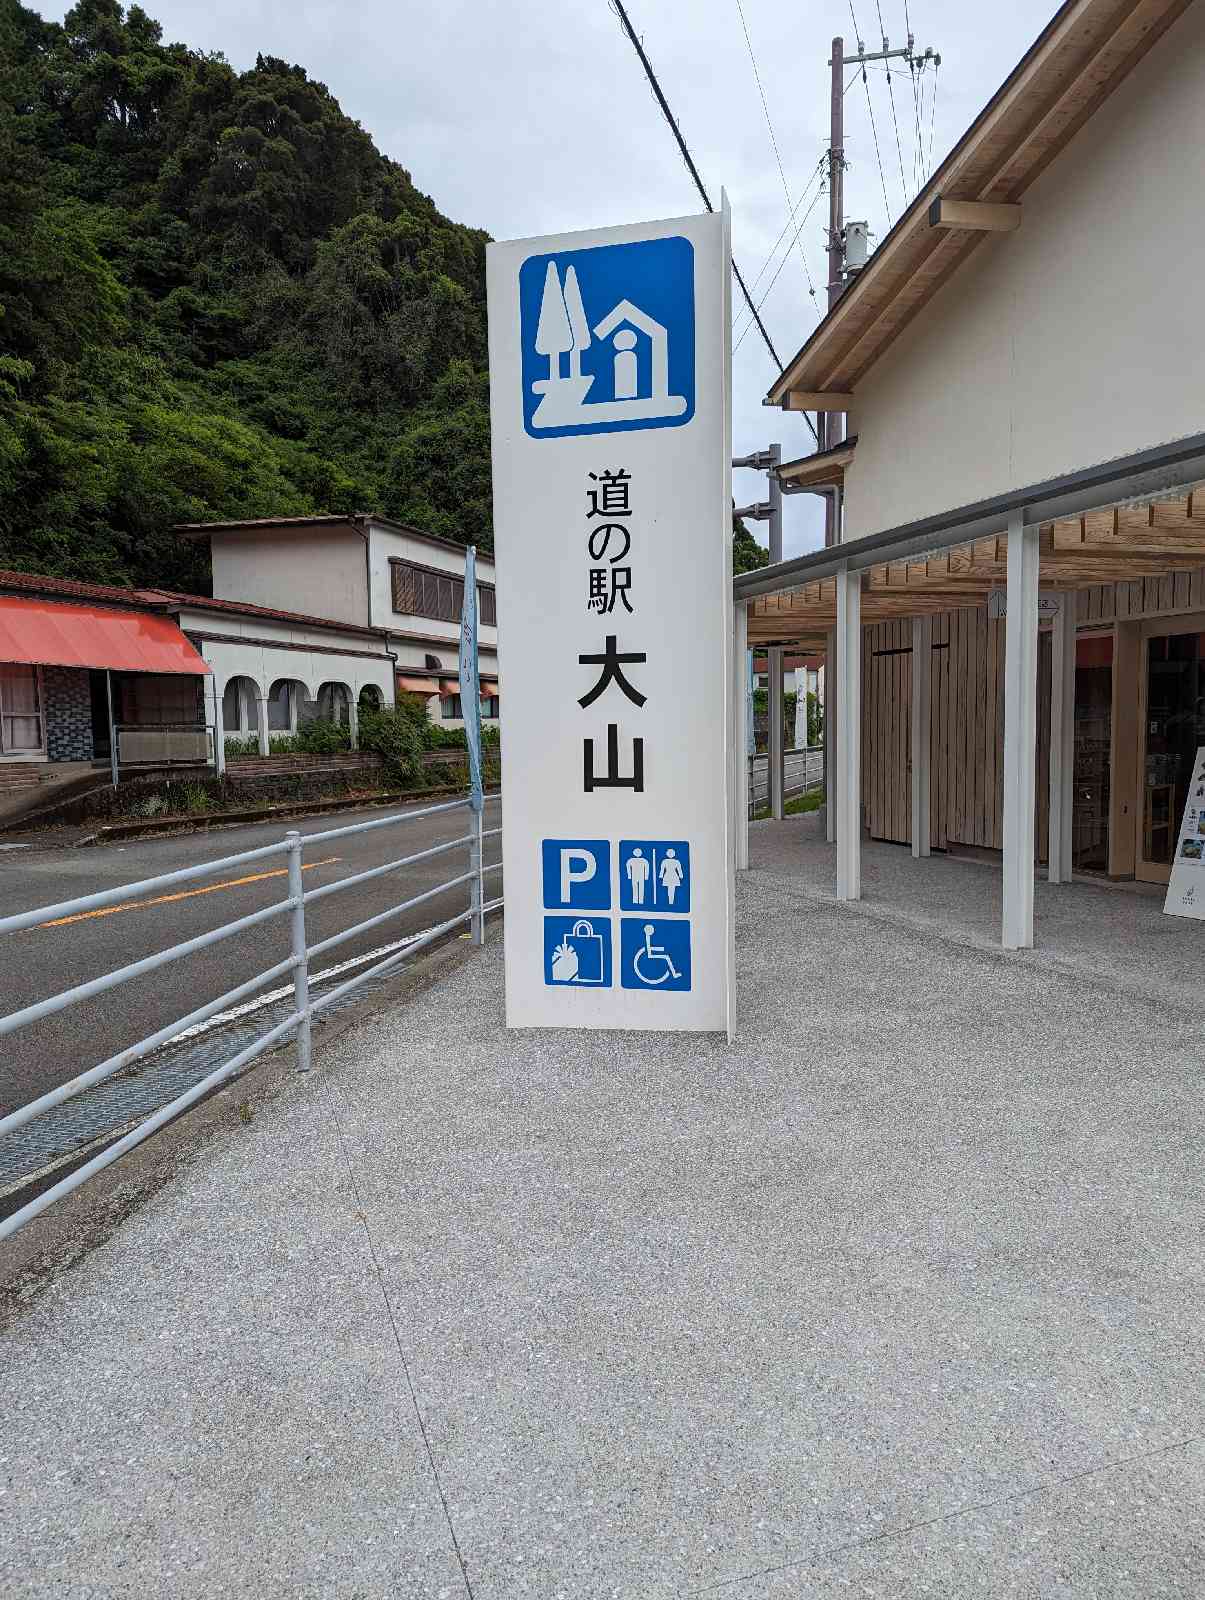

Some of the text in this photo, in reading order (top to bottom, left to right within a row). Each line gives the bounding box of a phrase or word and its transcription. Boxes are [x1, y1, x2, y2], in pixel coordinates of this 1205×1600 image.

[576, 468, 648, 793] 道の駅 大山
[560, 848, 597, 903] P
